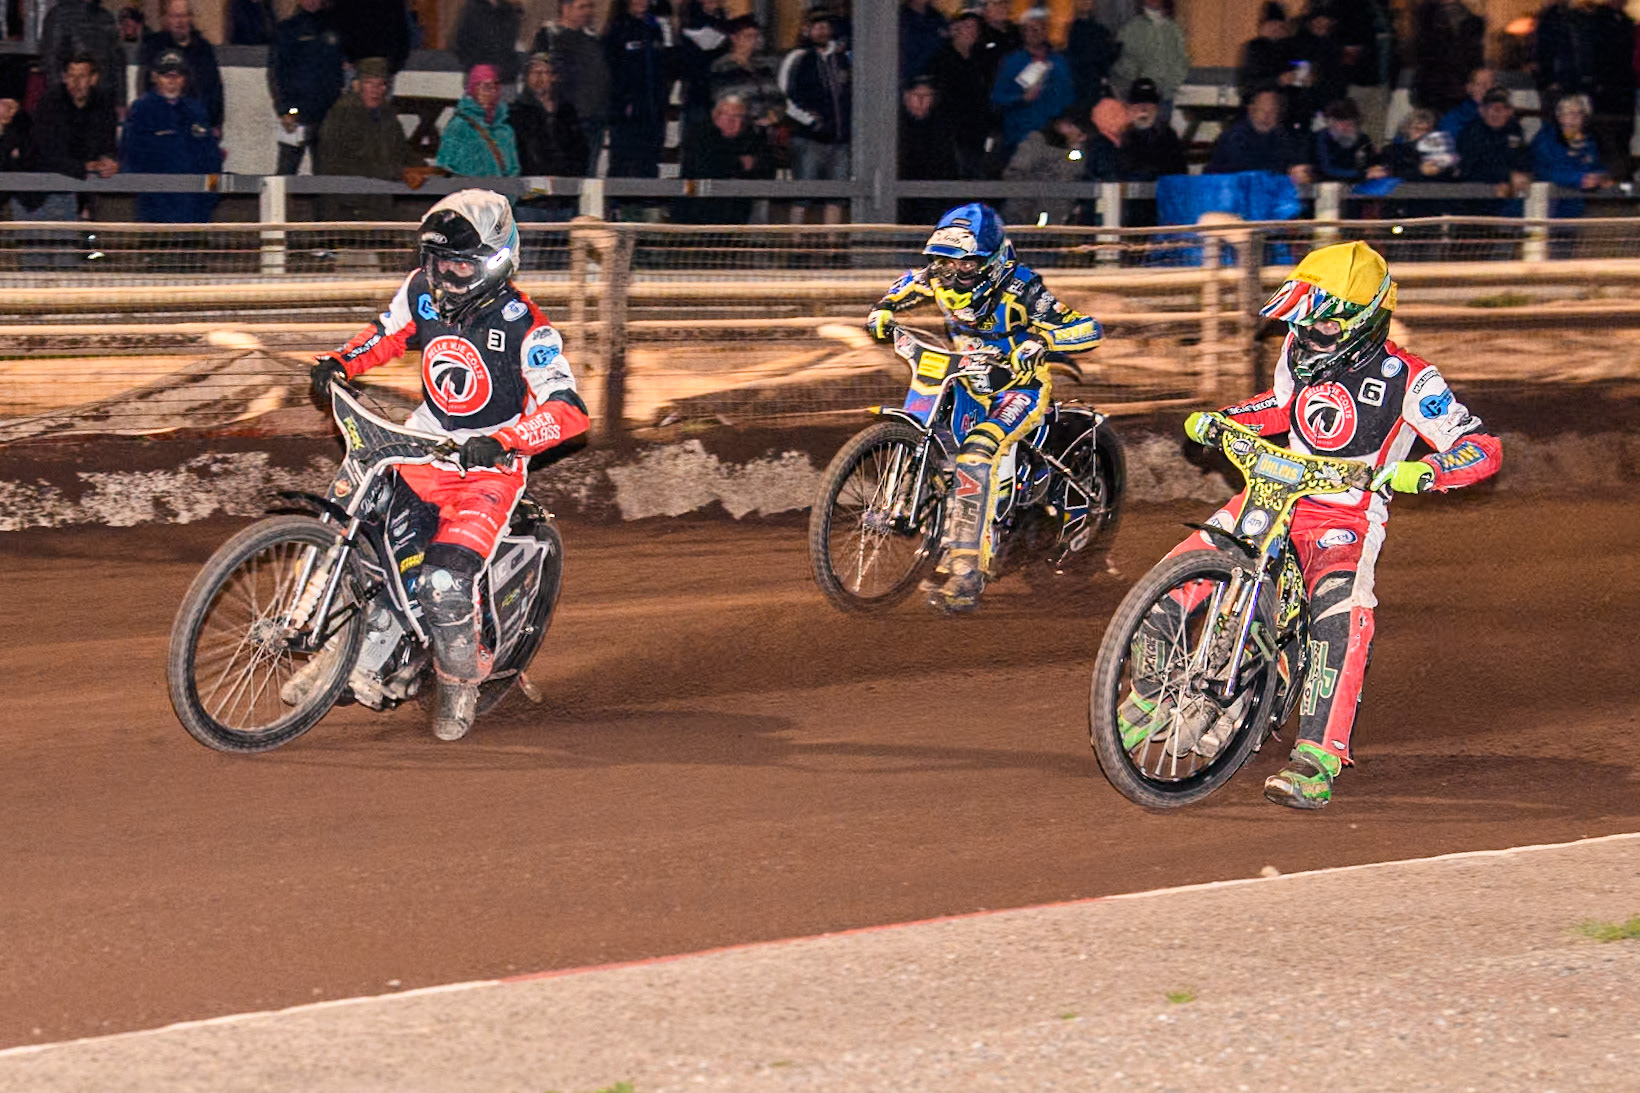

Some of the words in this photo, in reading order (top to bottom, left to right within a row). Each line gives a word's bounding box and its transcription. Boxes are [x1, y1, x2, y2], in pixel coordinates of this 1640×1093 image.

[1362, 382, 1382, 402] 6
[1340, 394, 1353, 419] COLTS
[528, 424, 561, 446] CLASS
